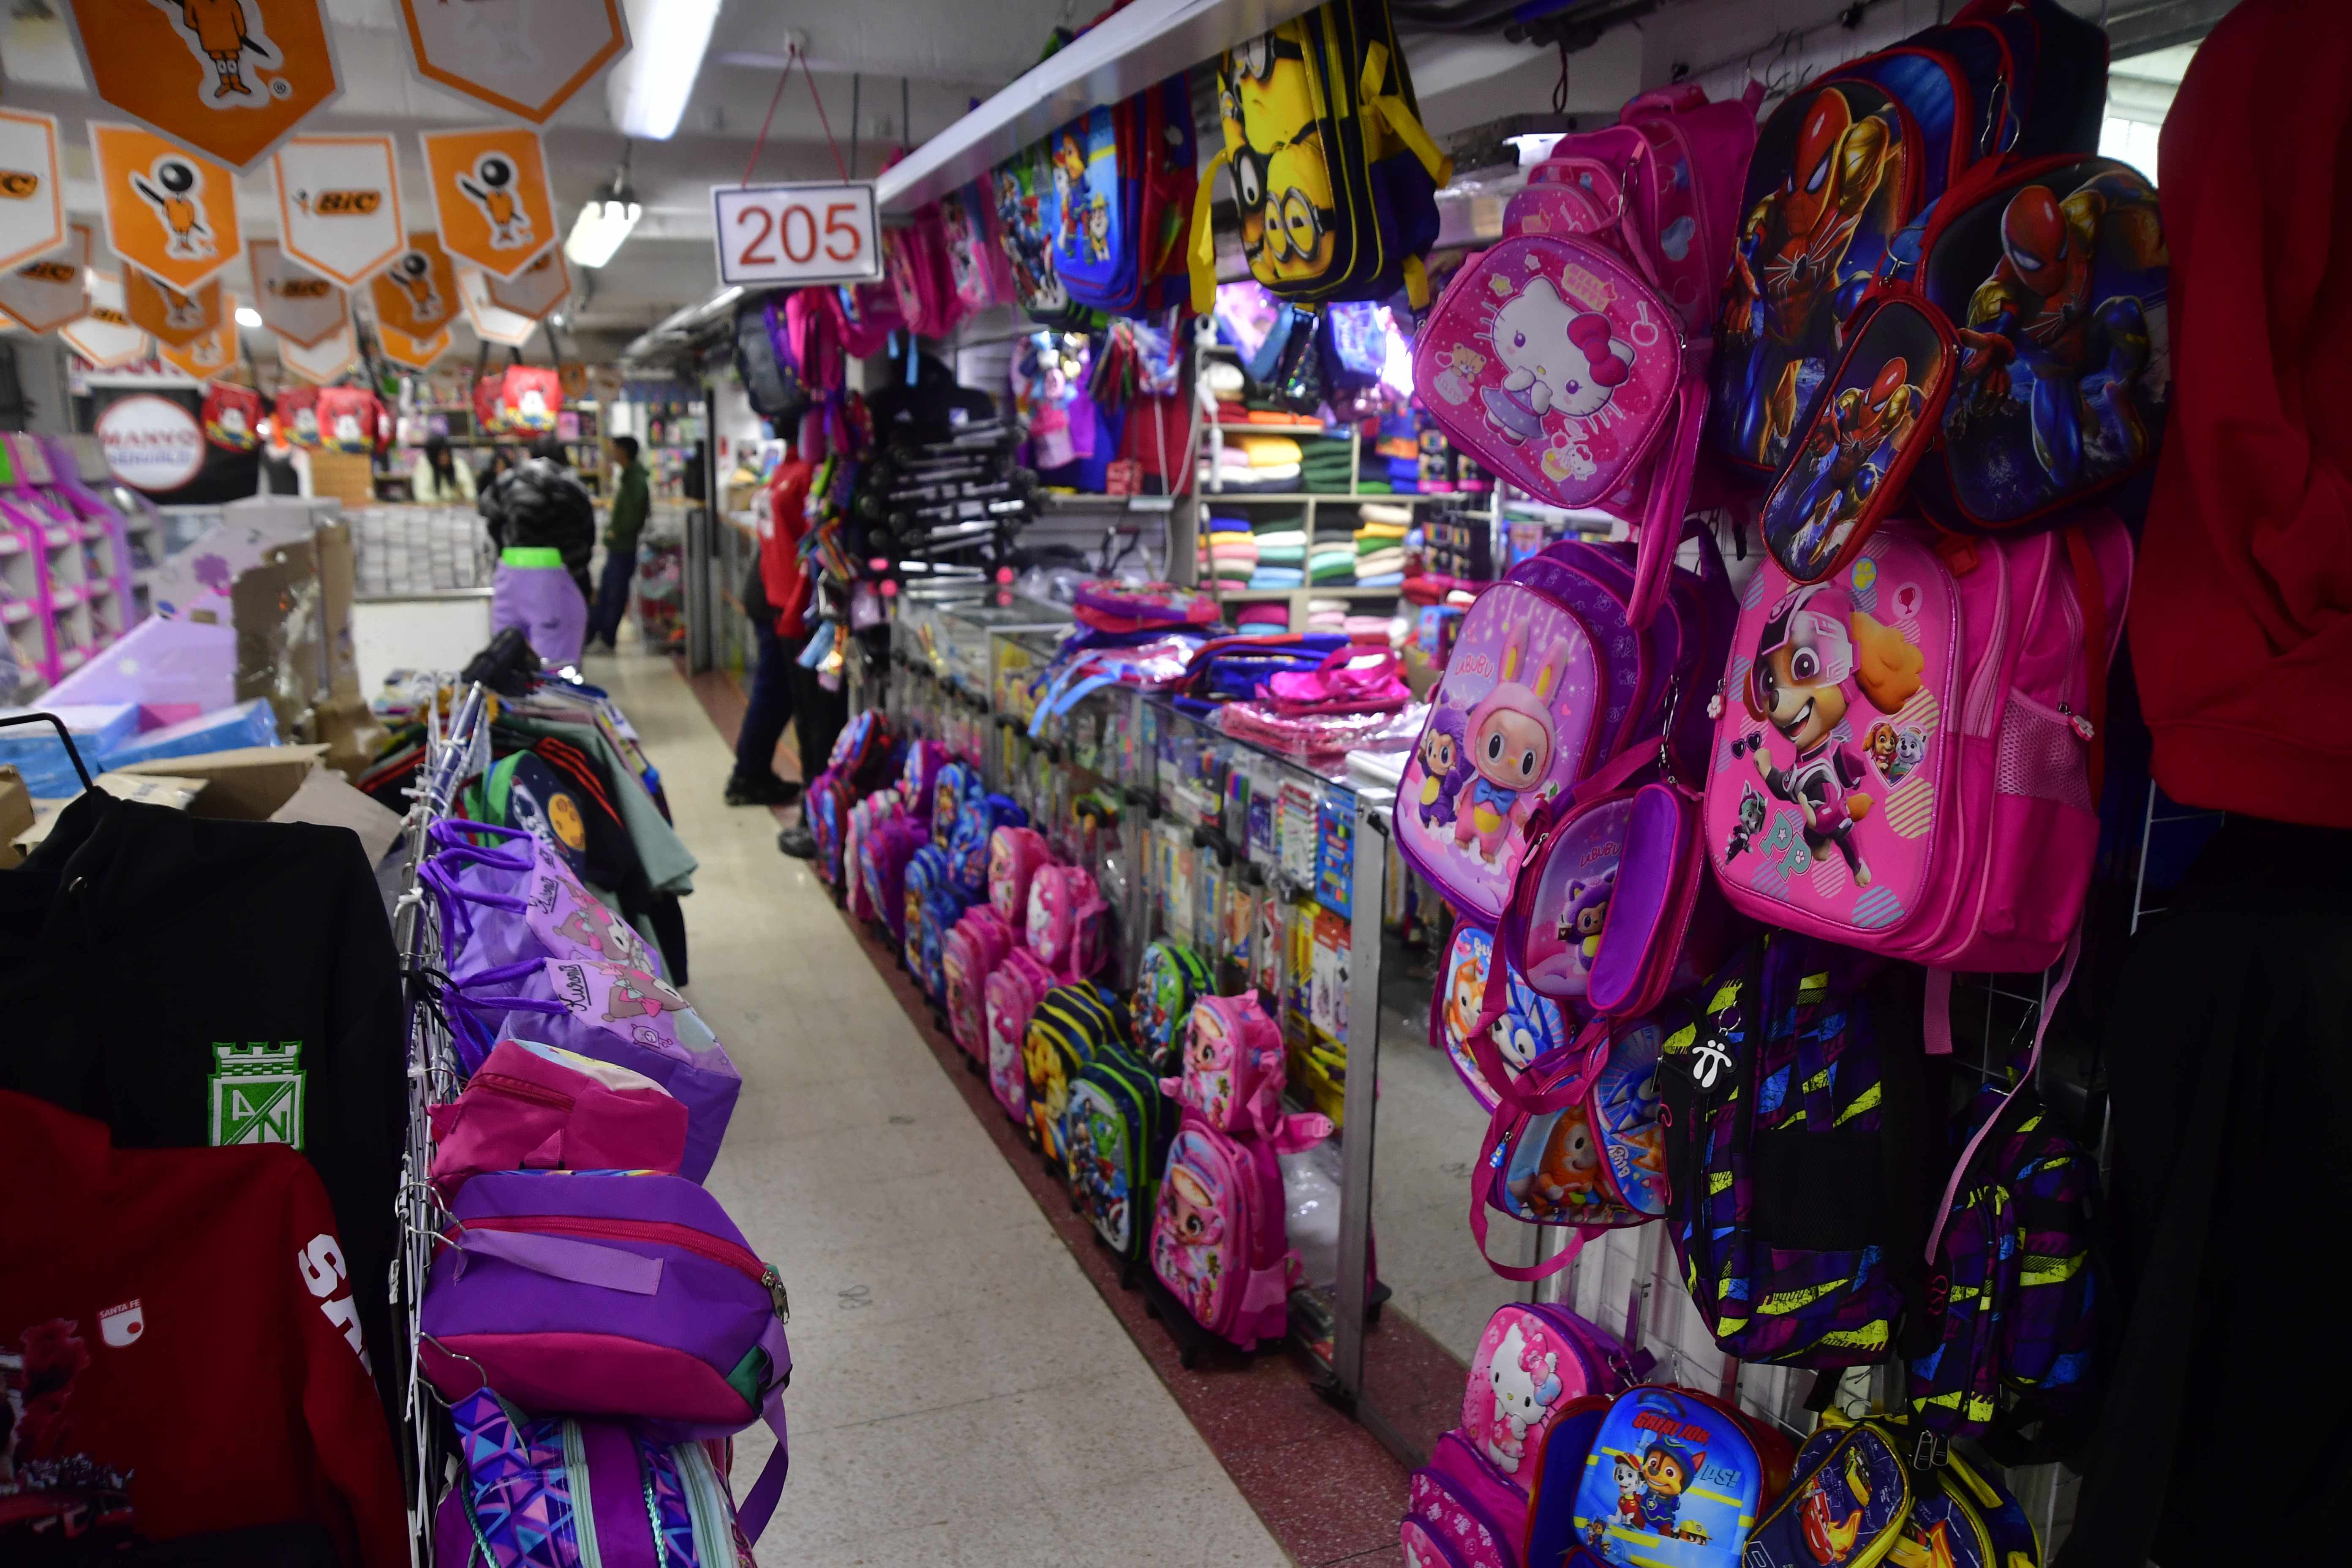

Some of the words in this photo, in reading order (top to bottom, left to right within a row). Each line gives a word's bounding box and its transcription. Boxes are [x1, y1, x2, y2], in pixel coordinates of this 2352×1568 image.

[319, 193, 377, 212] BIC
[738, 204, 860, 264] 205
[1580, 842, 1622, 868] LABUBU
[100, 1304, 128, 1318] SANTA
[130, 1298, 140, 1309] FE
[1633, 1411, 1683, 1436] GREAT
